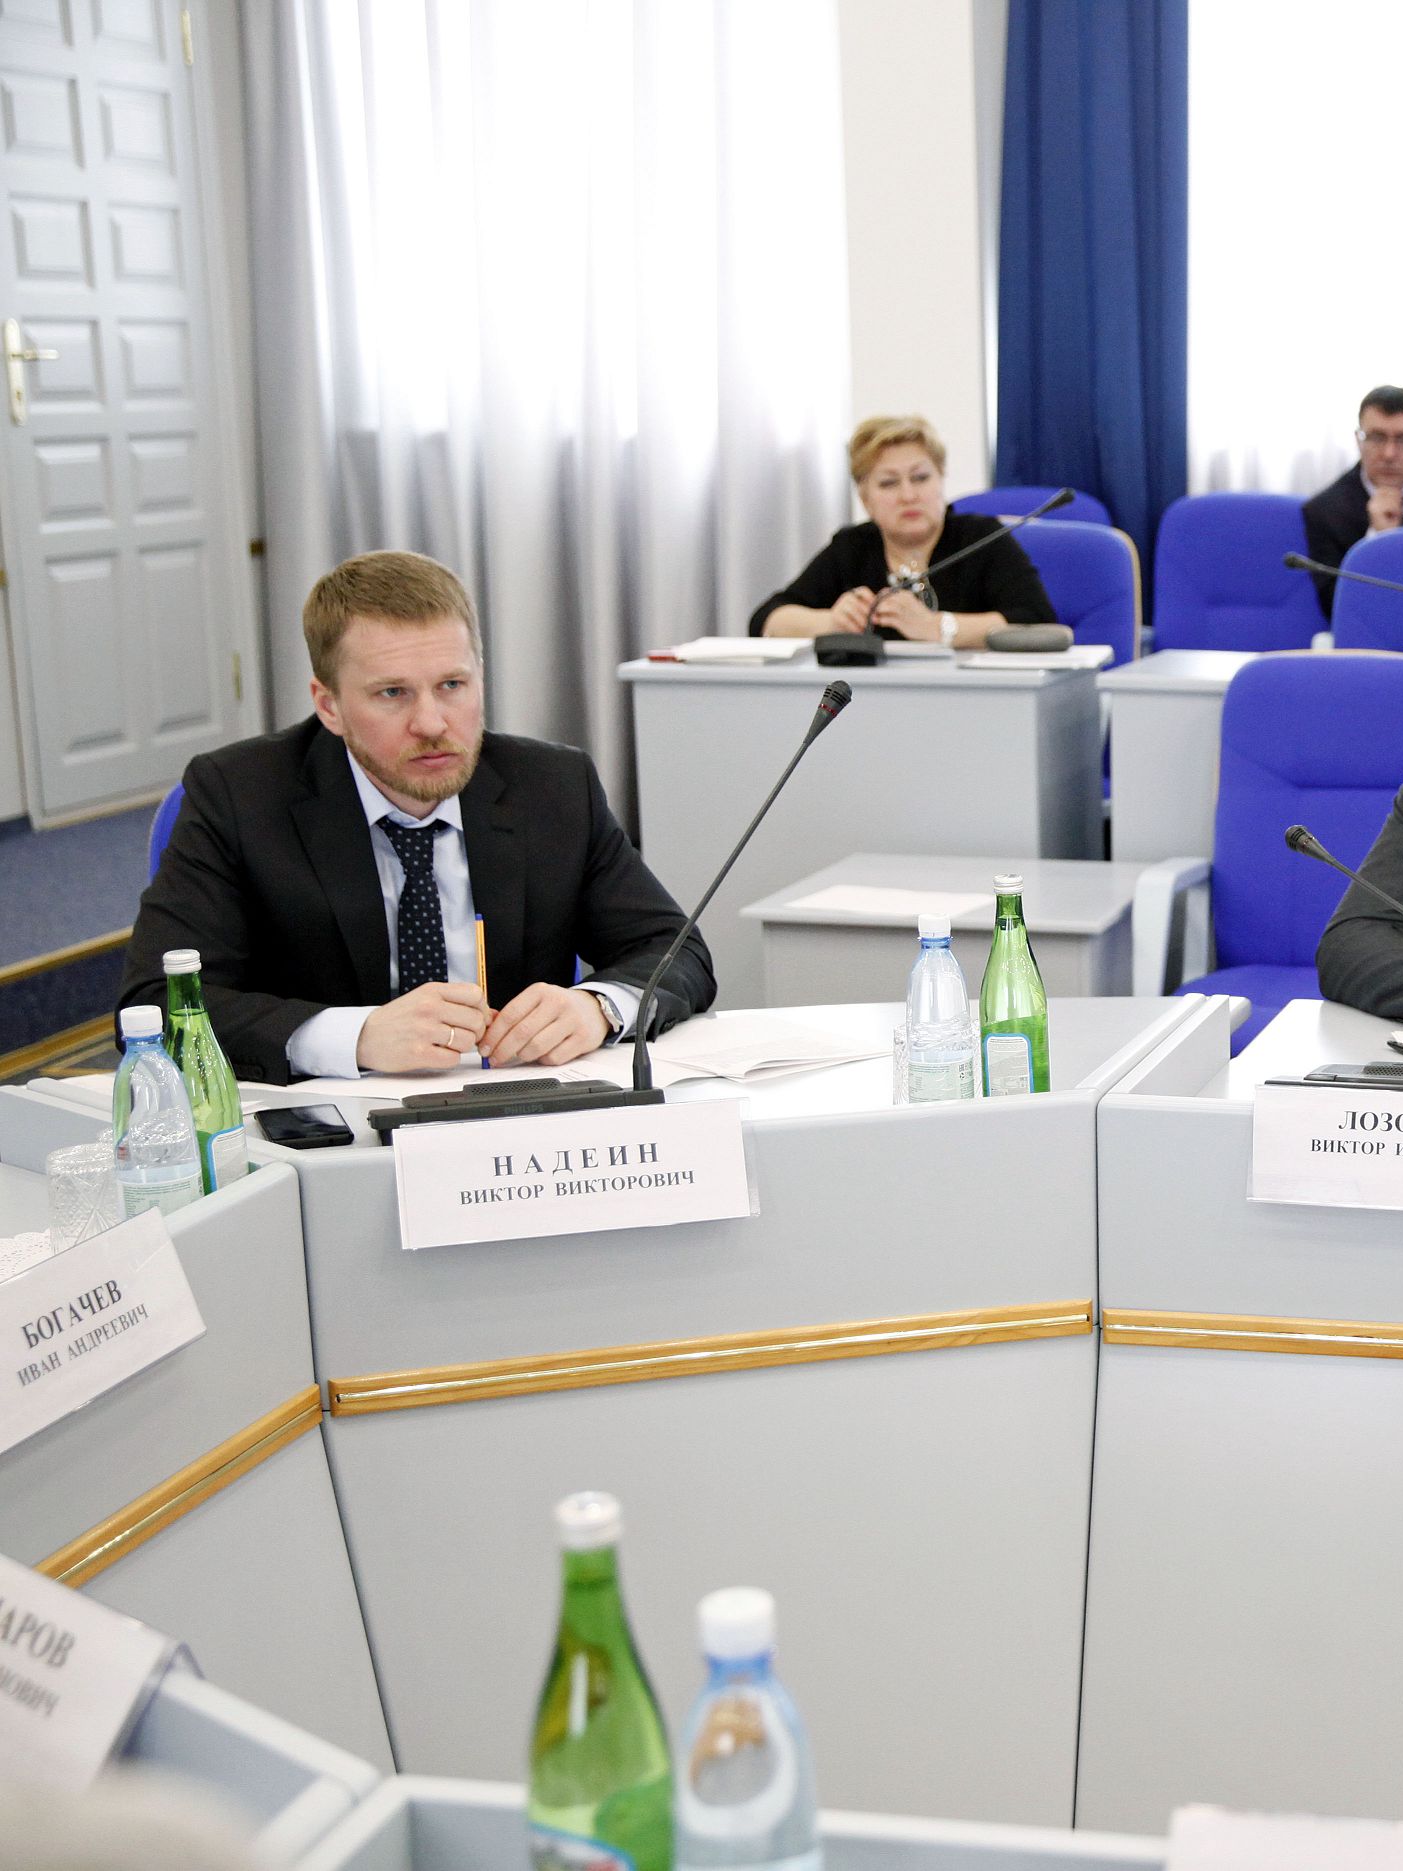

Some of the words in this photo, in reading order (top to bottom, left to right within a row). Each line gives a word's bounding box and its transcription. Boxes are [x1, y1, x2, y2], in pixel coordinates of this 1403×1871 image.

[492, 1142, 659, 1177] НАДЕИН
[1310, 1138, 1386, 1156] ВИКТОР
[459, 1184, 545, 1206] ВИКТОР
[555, 1170, 695, 1197] ВИКТОРОВИЧ
[20, 1279, 122, 1349] БОГАЧЕВ
[16, 1351, 62, 1387] ИВАН
[67, 1303, 149, 1361] АНДРЕЕВИЧ
[0, 1597, 75, 1668] АРОВ
